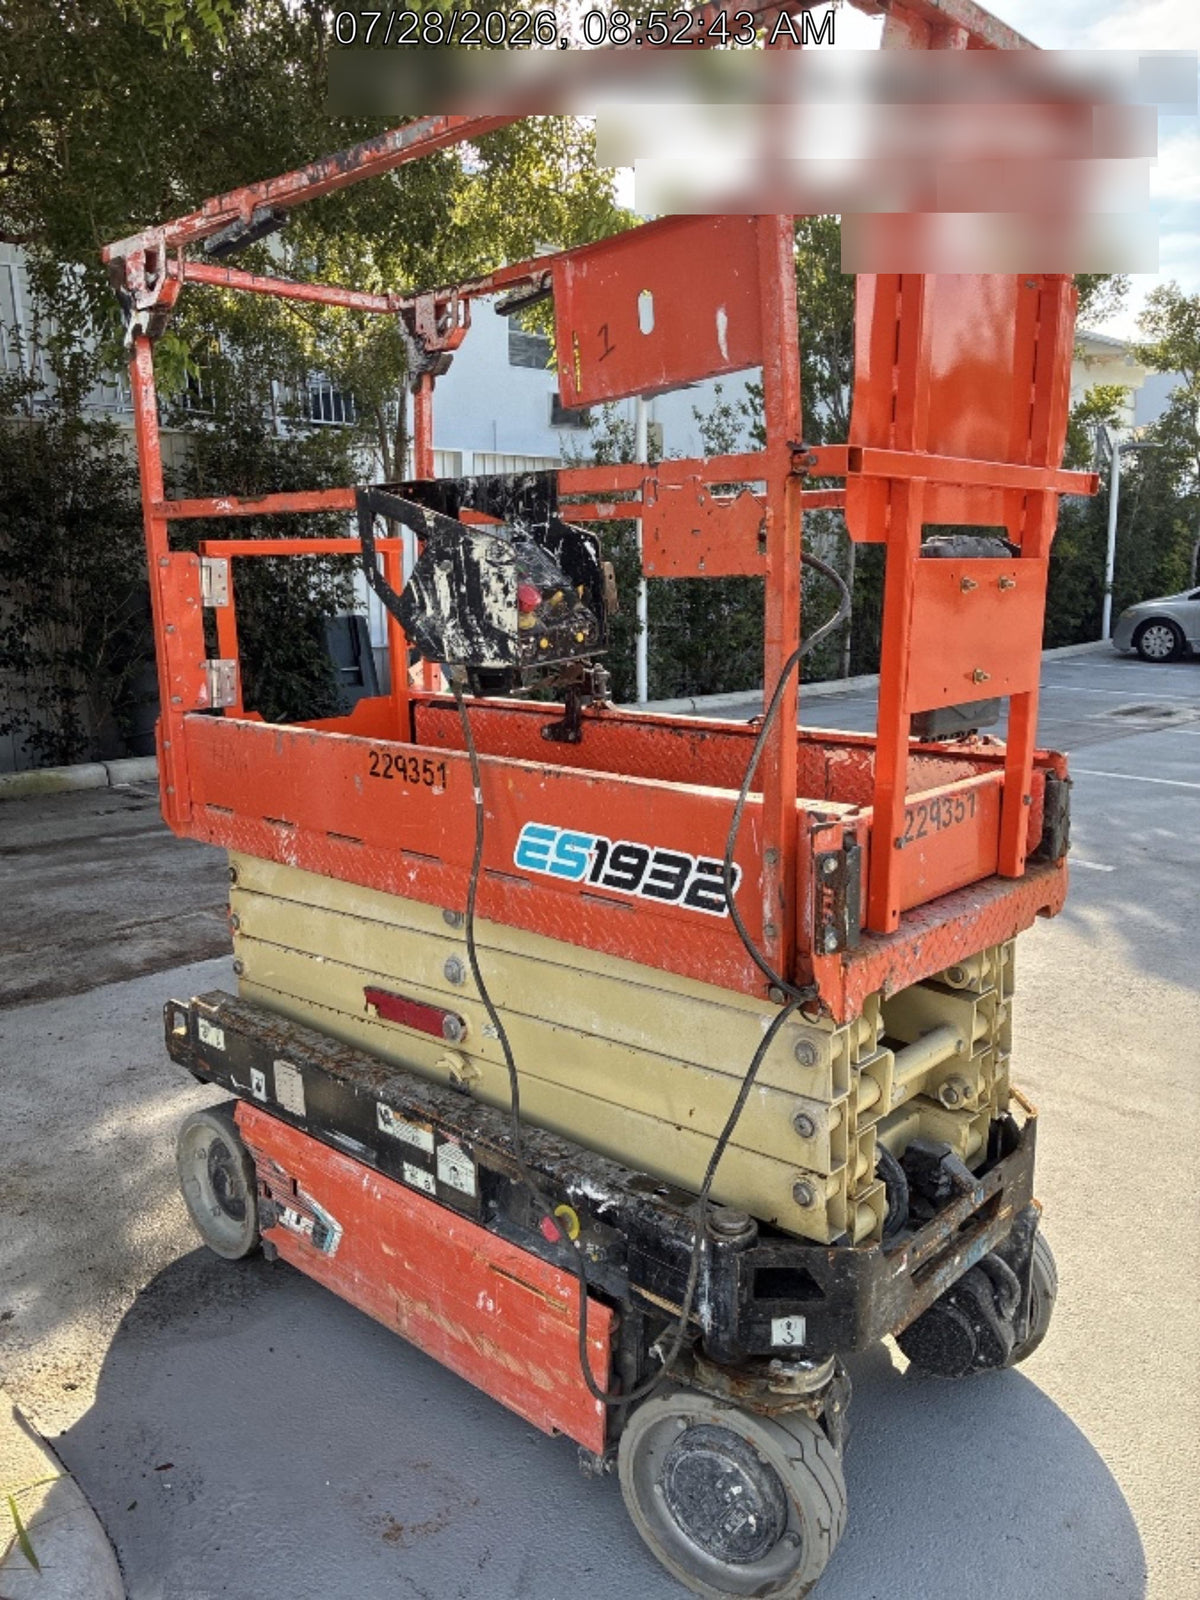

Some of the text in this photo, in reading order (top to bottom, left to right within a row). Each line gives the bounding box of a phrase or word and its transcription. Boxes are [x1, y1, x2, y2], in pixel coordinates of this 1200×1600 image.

[368, 750, 447, 789] 229351
[904, 792, 976, 843] 229351
[514, 823, 741, 915] ES1932
